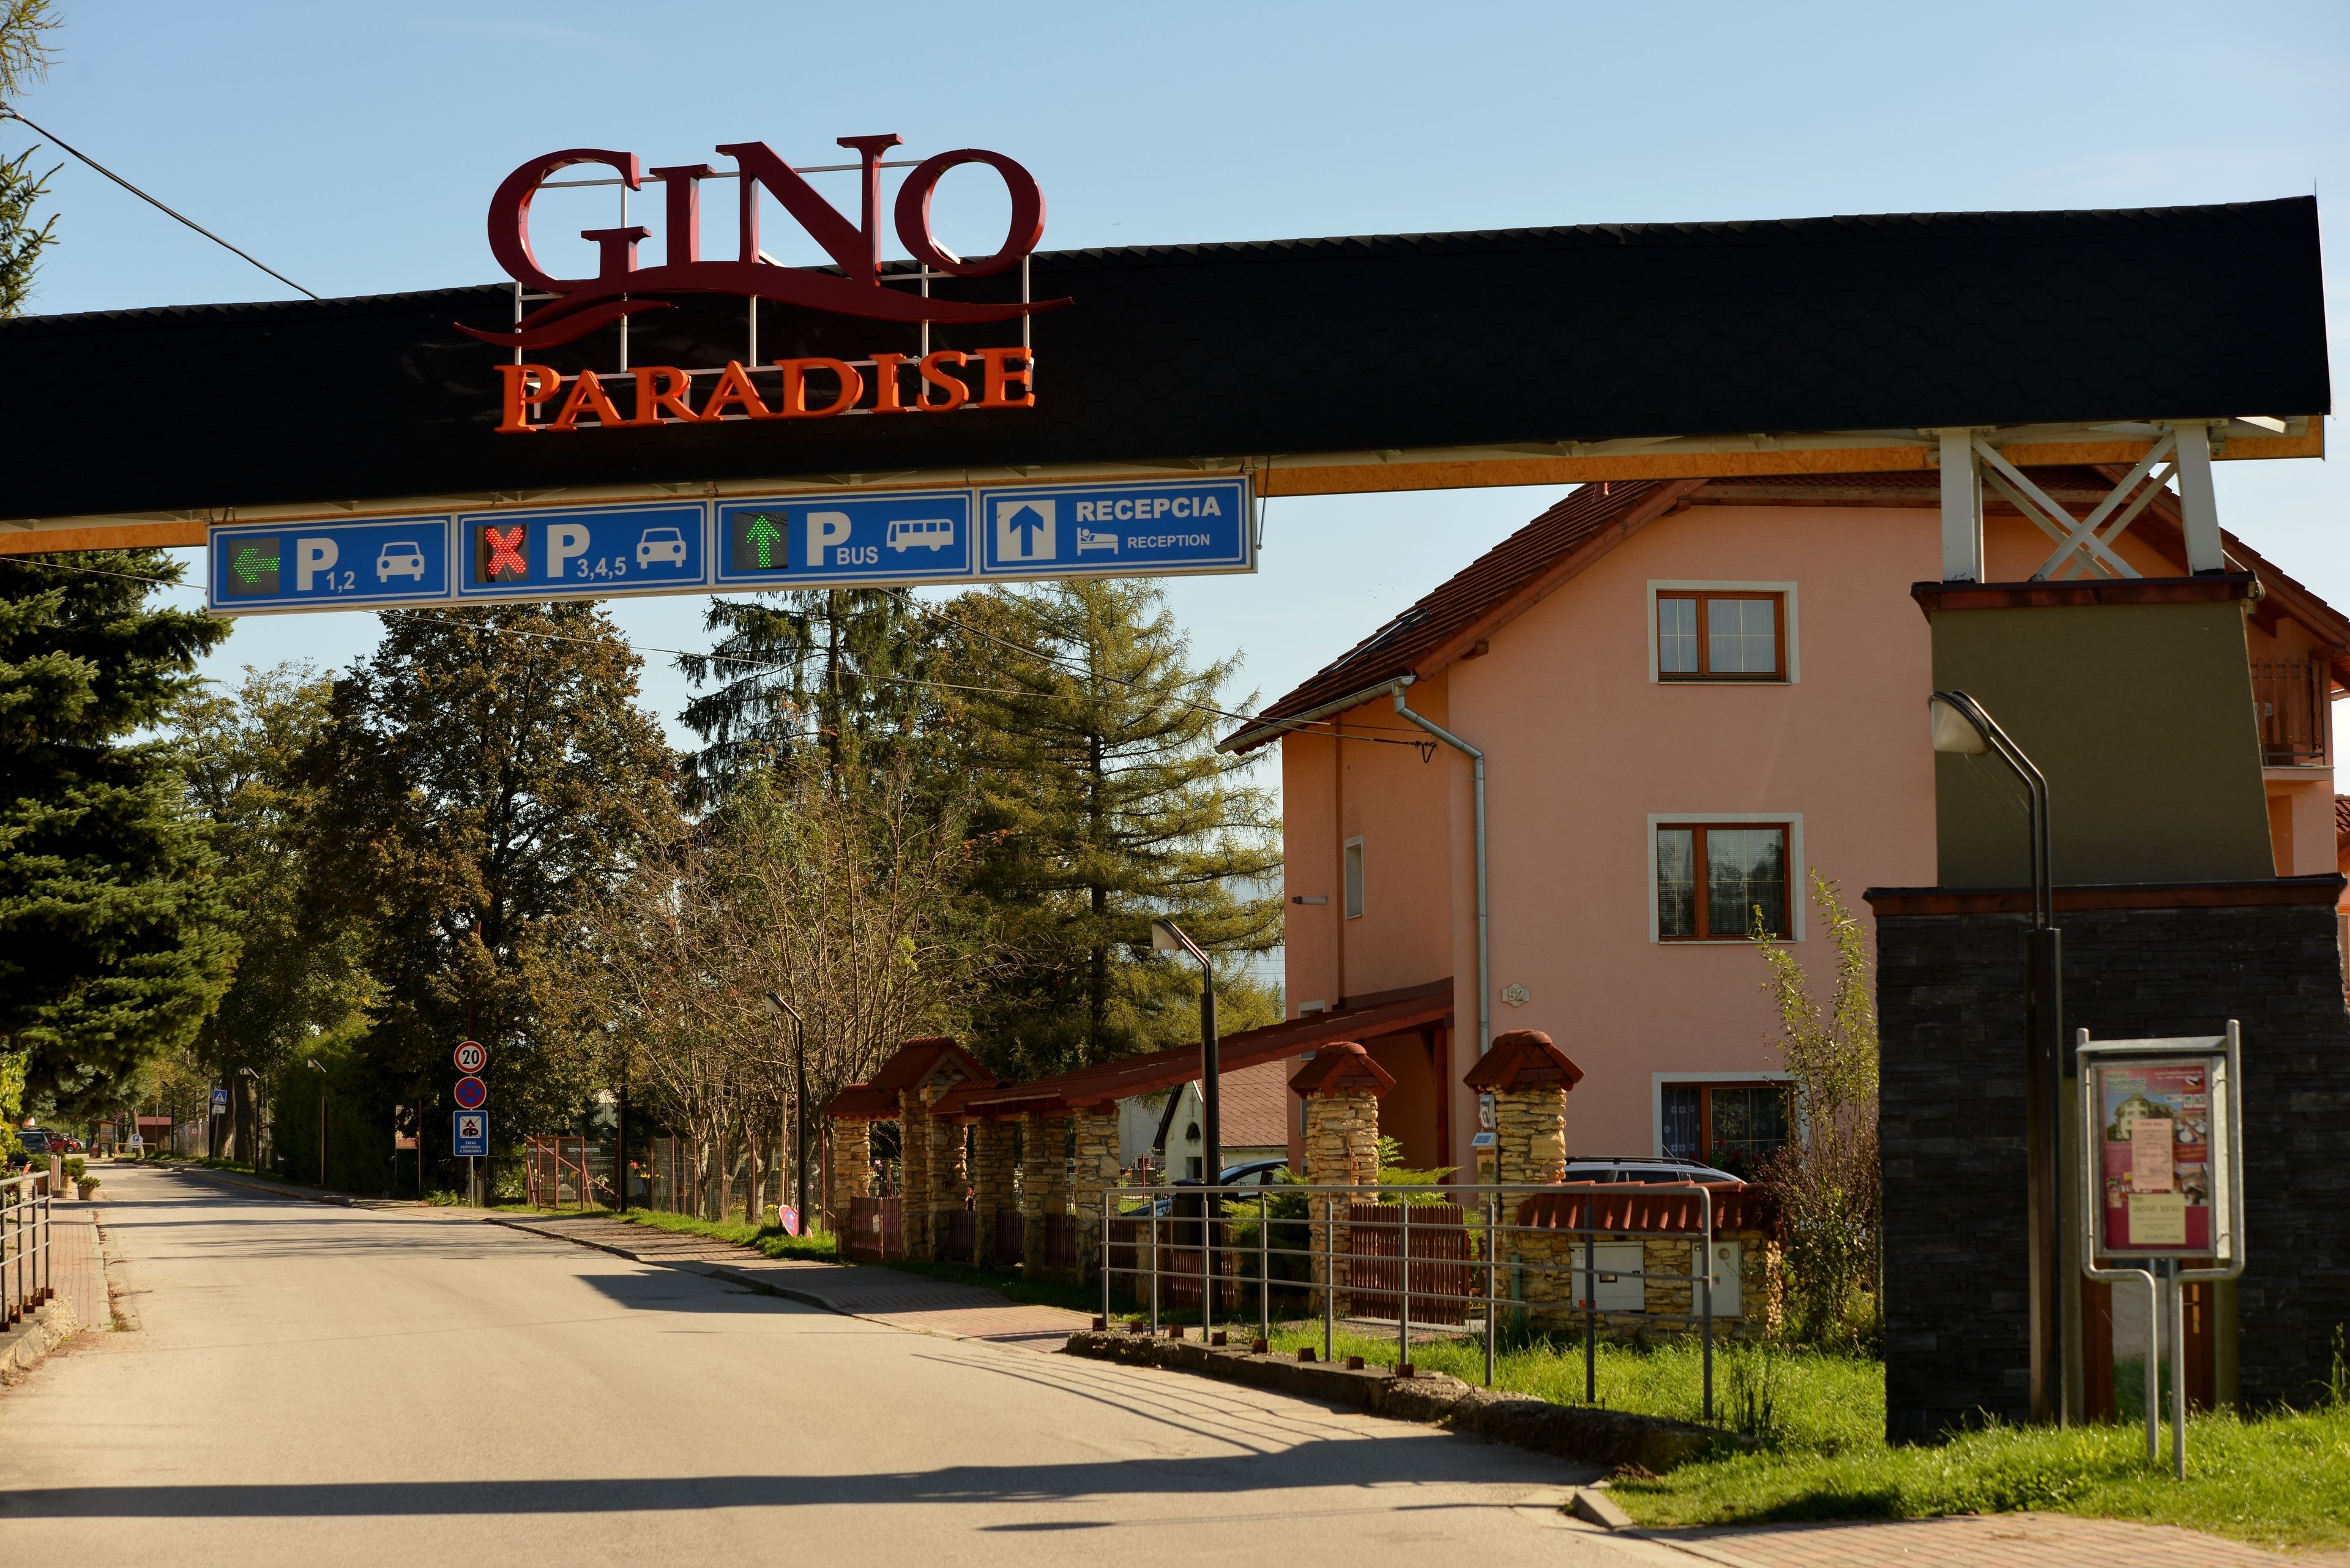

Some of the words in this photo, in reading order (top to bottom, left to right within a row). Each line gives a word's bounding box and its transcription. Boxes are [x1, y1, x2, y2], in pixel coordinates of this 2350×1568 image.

[488, 133, 1046, 293] GINO
[494, 346, 1035, 433] PARADISE
[1076, 496, 1222, 522] RECEPCIA
[548, 524, 591, 578] P
[807, 512, 852, 566] P
[1128, 534, 1210, 548] RECEPTION
[297, 537, 338, 591] P
[837, 546, 878, 565] BUS
[577, 557, 626, 580] 3,4,5
[327, 571, 355, 593] 1,2
[1507, 988, 1524, 1002] 52
[462, 1049, 480, 1065] 20
